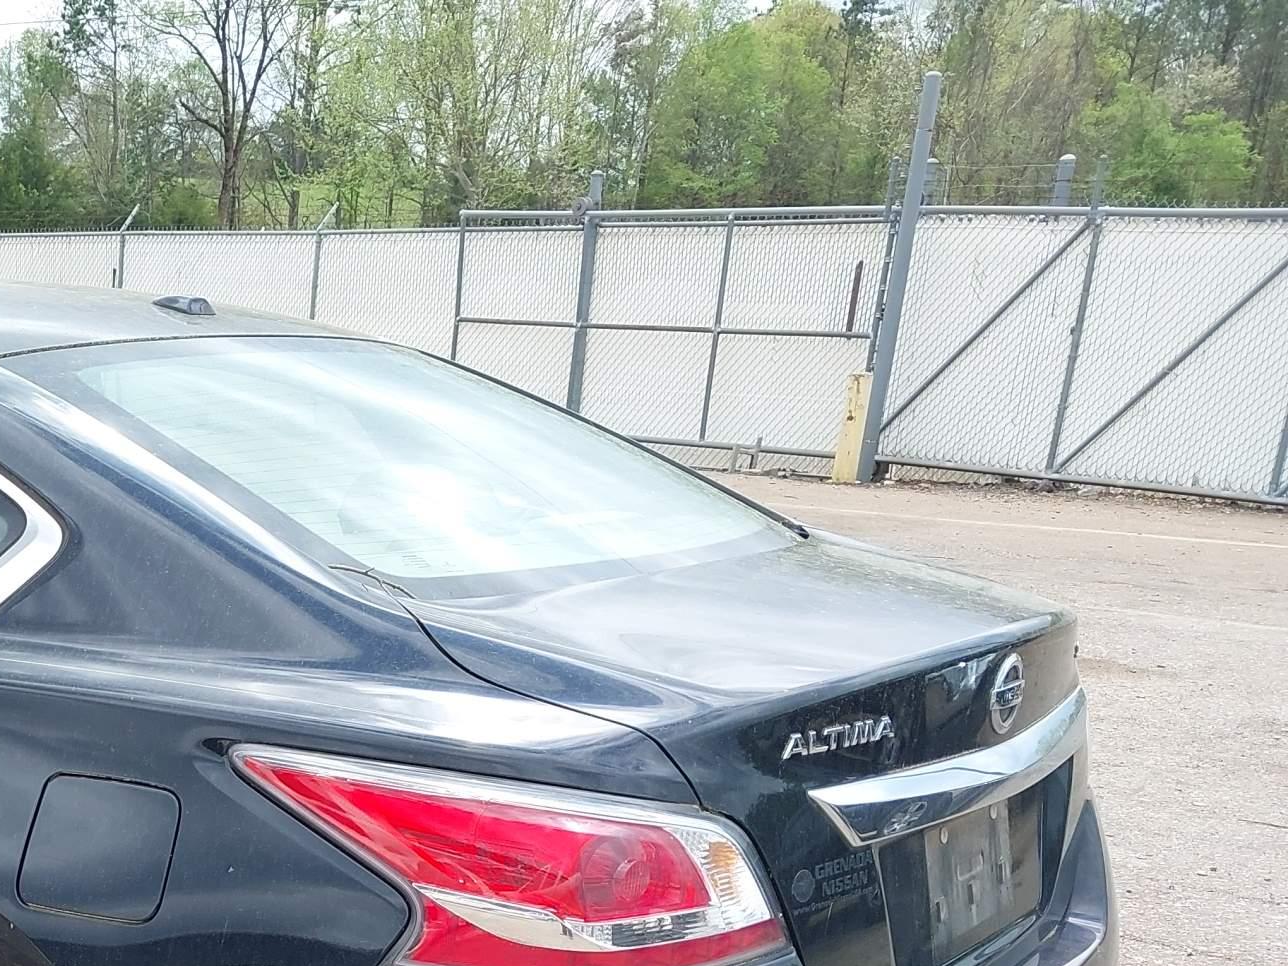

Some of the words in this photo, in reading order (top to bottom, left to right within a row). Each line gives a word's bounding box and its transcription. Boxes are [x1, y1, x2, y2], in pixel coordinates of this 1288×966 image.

[781, 715, 895, 760] ALTIMA
[814, 849, 873, 880] GRENADA
[822, 869, 869, 897] NISSAN
